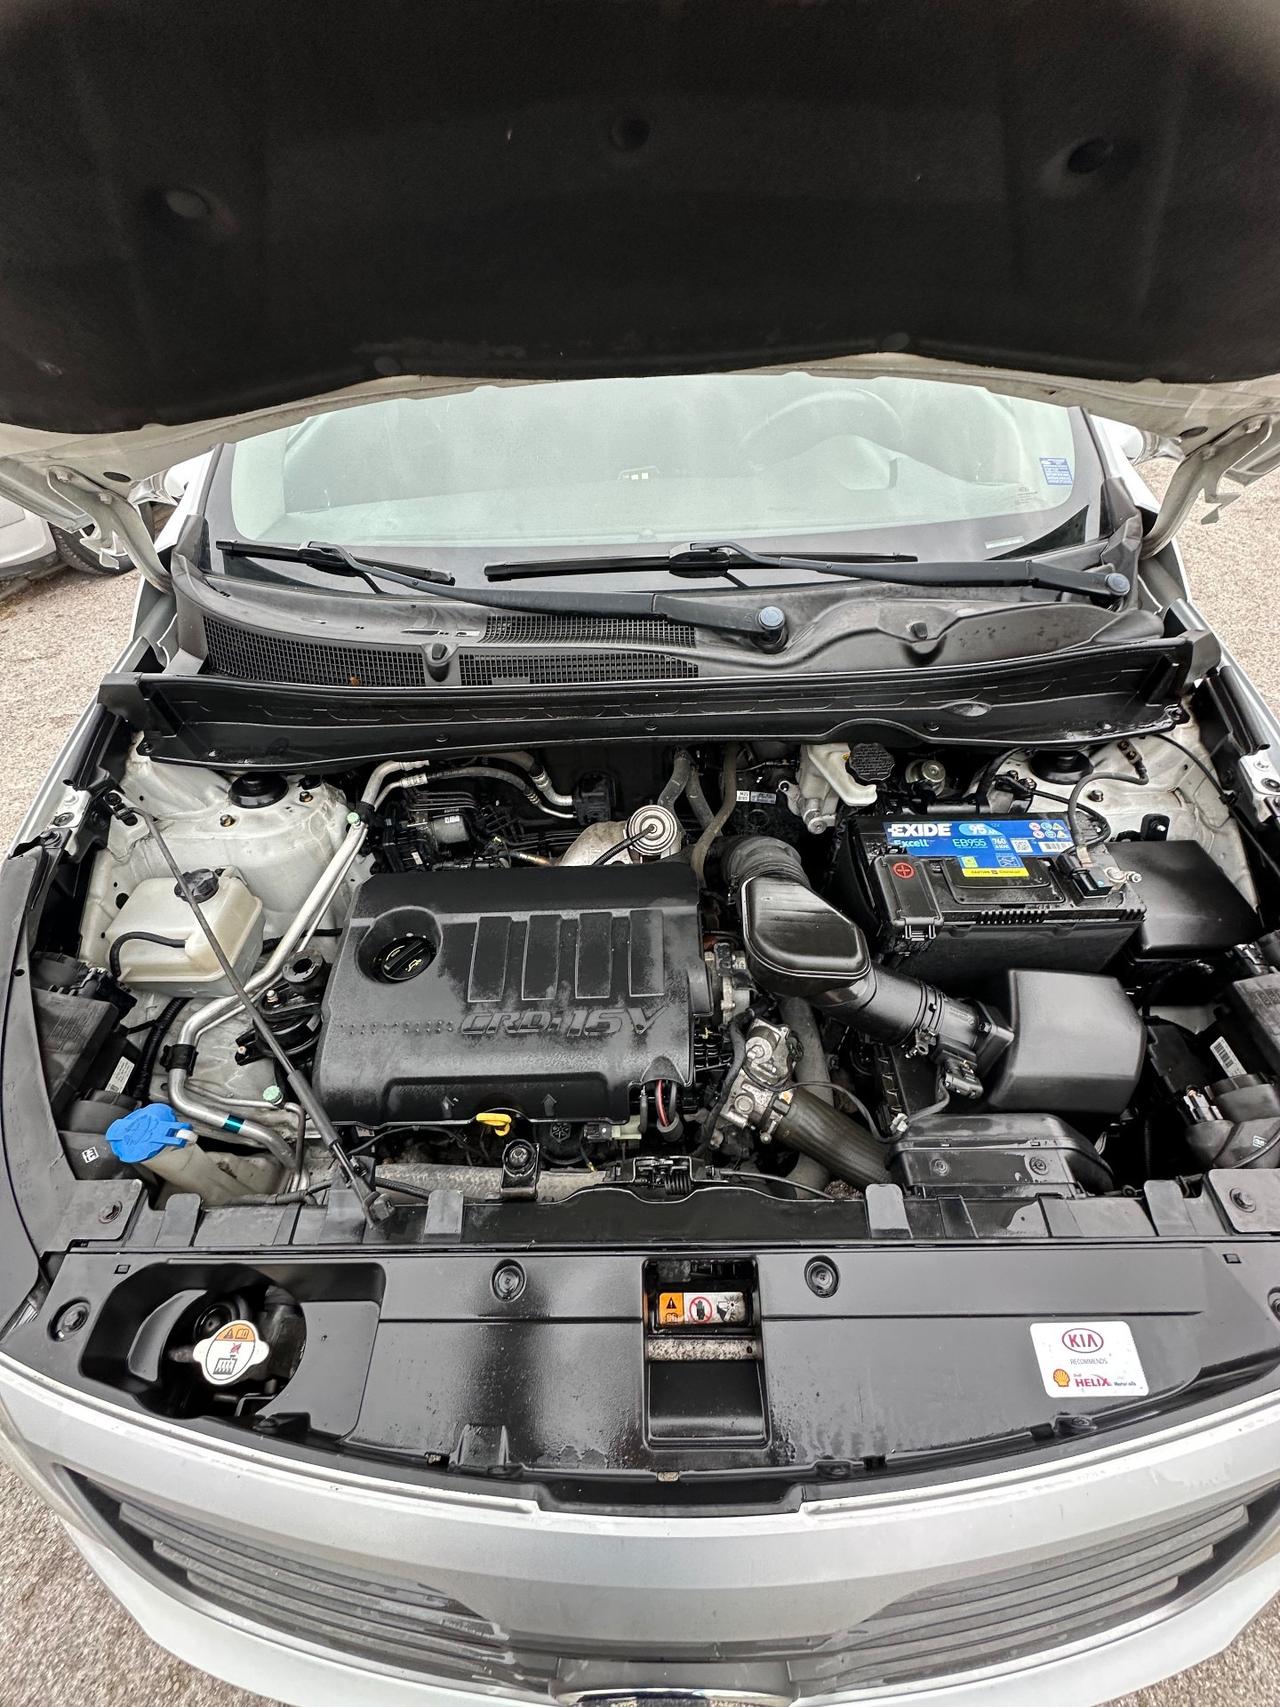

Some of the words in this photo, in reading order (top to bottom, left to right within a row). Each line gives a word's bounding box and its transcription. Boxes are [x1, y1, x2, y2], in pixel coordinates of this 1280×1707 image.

[888, 823, 952, 837] EXIDE
[968, 823, 988, 835] 95
[893, 839, 930, 848] Excell
[952, 838, 987, 848] EB955
[1068, 1333, 1099, 1348] KIA
[1074, 1378, 1112, 1387] HELIX
